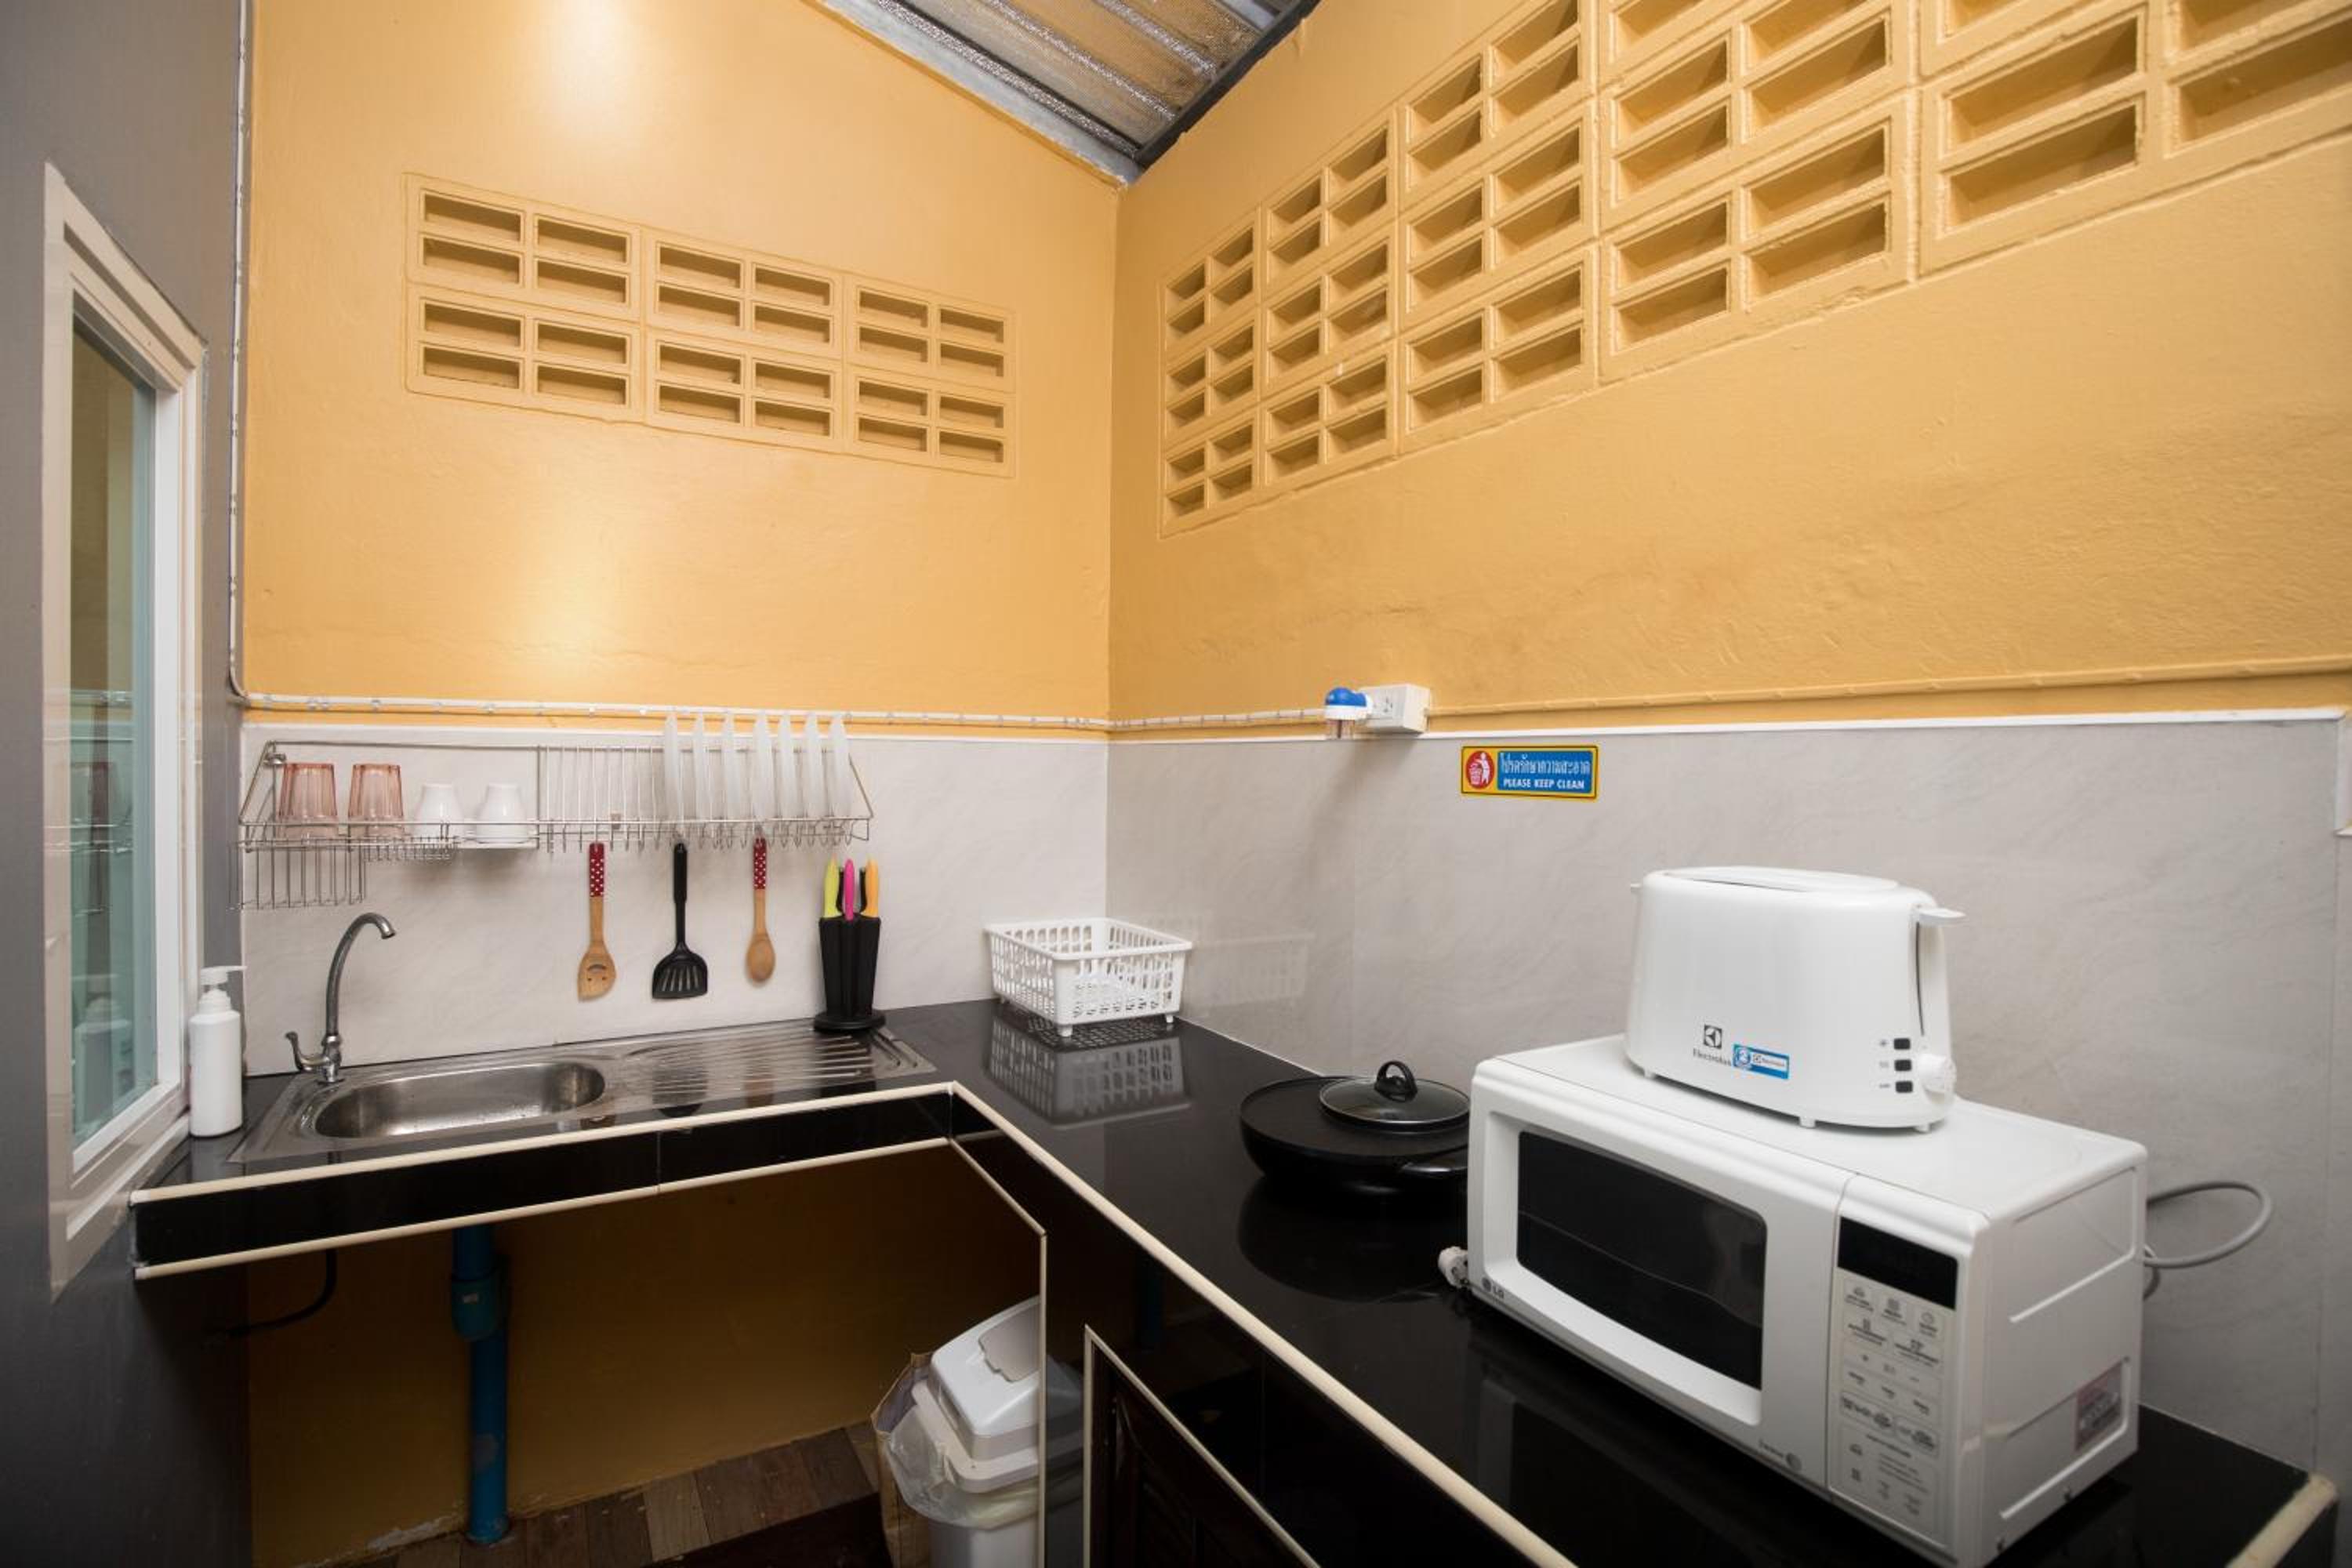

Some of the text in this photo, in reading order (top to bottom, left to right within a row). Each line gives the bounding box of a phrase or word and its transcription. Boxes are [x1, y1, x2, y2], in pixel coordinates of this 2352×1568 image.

[1504, 779, 1584, 789] PLEASE KEEP CLEAN
